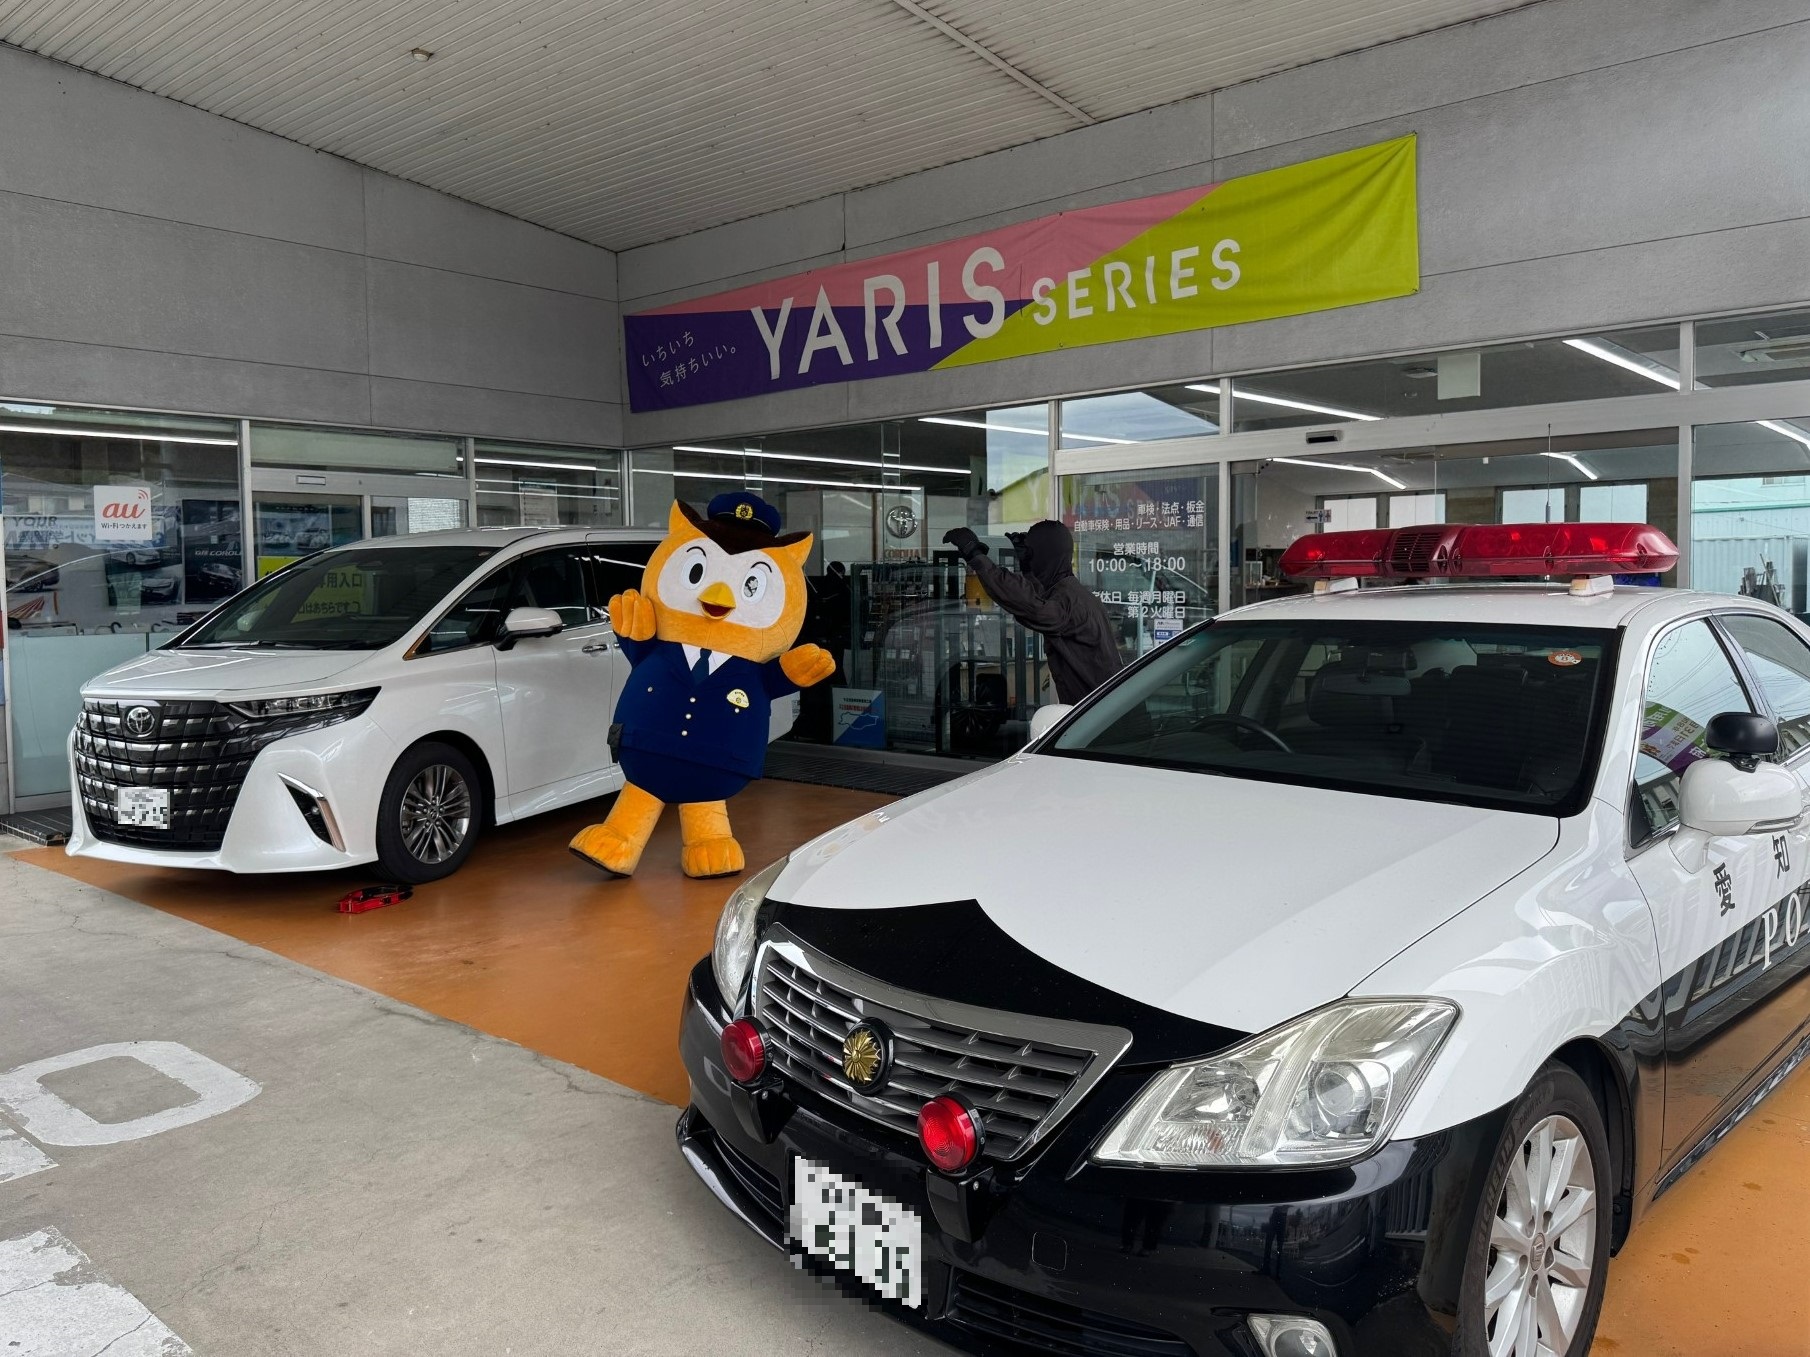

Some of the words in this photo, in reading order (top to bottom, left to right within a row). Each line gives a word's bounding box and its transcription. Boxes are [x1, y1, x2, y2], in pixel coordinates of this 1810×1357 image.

[750, 246, 1006, 380] YARIS
[1031, 238, 1242, 326] SERIES
[642, 330, 695, 367] いちいち
[659, 344, 737, 388] 気持ちいい。
[102, 502, 146, 519] au
[1113, 541, 1160, 556] 営業時間
[1128, 590, 1186, 604] 毎週月曜日
